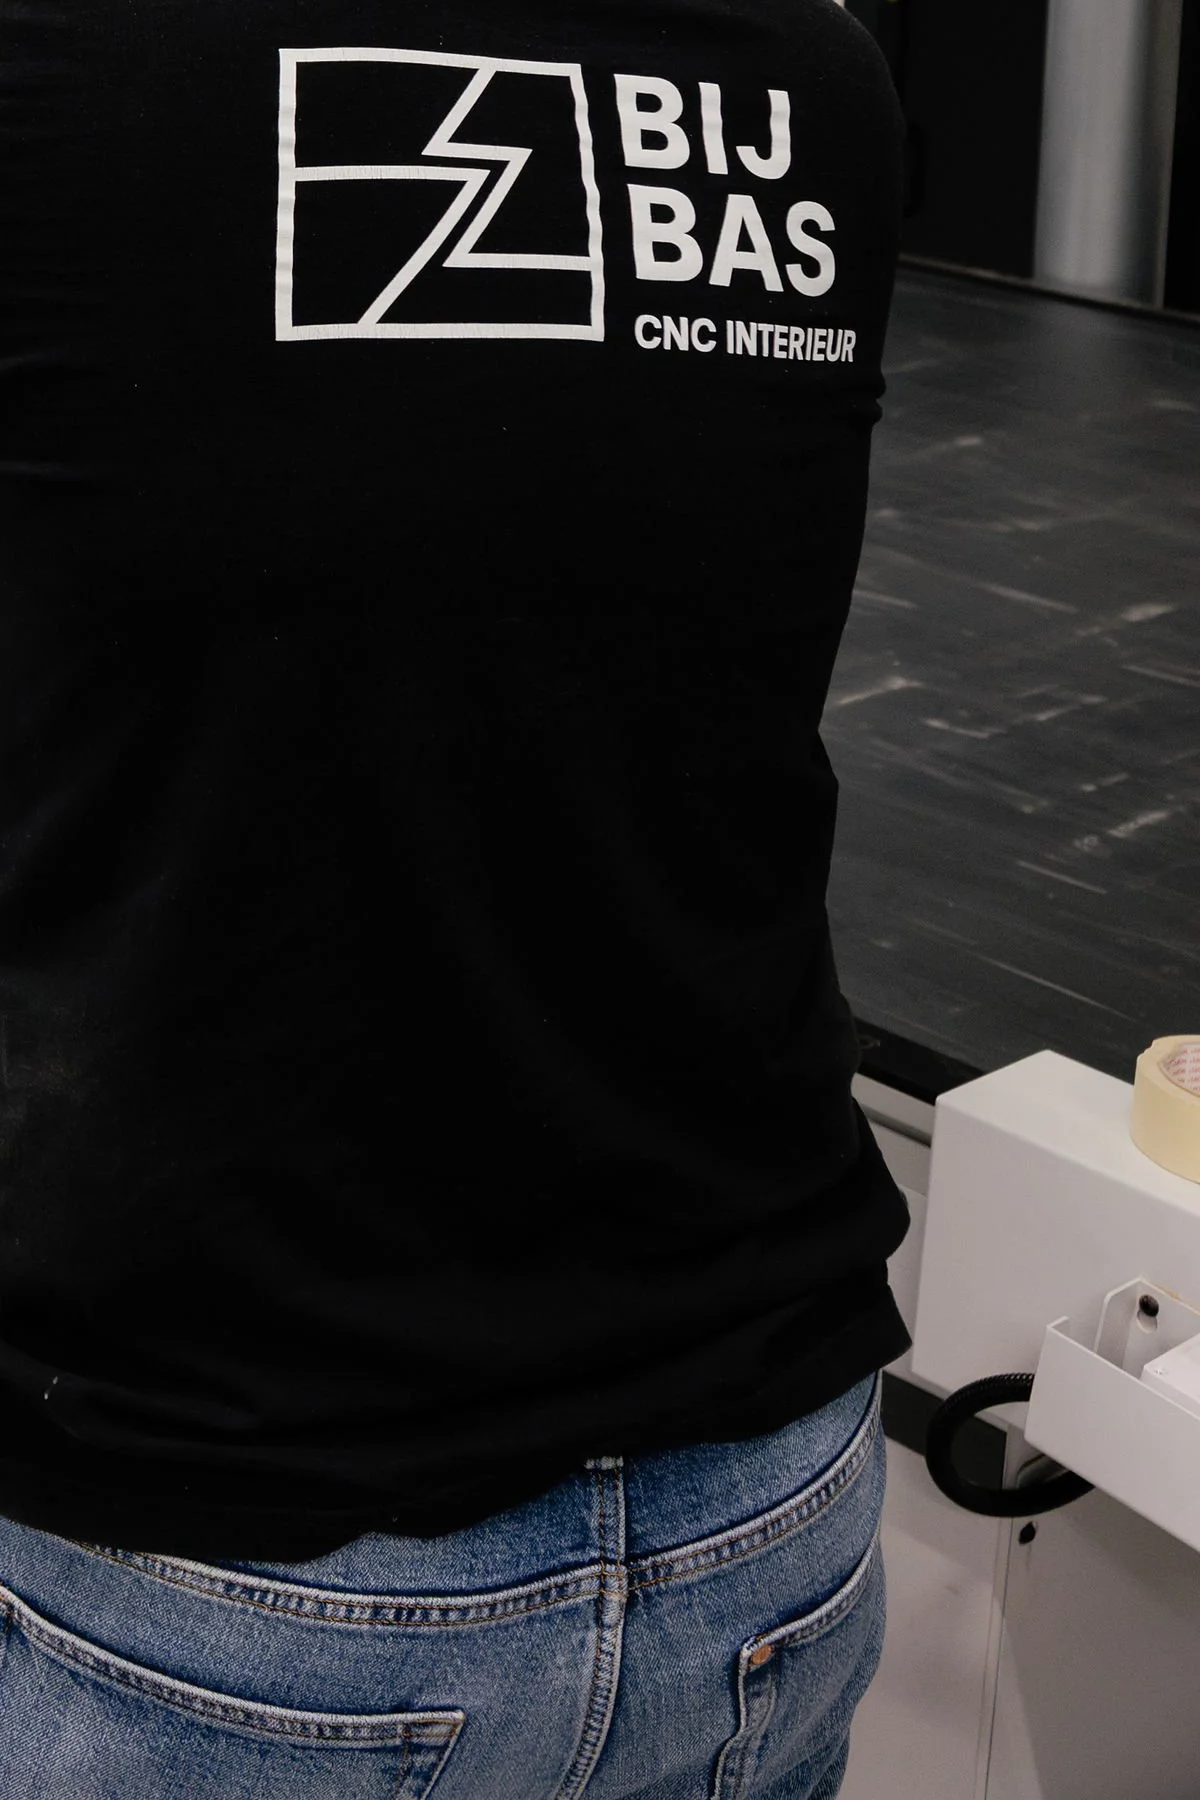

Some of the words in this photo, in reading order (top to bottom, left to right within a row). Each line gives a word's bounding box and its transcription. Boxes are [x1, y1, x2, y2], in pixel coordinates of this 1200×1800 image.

[613, 73, 792, 180] BIJ
[627, 184, 836, 297] BAS
[634, 314, 717, 352] CNC
[726, 319, 857, 363] INTERIEUR
